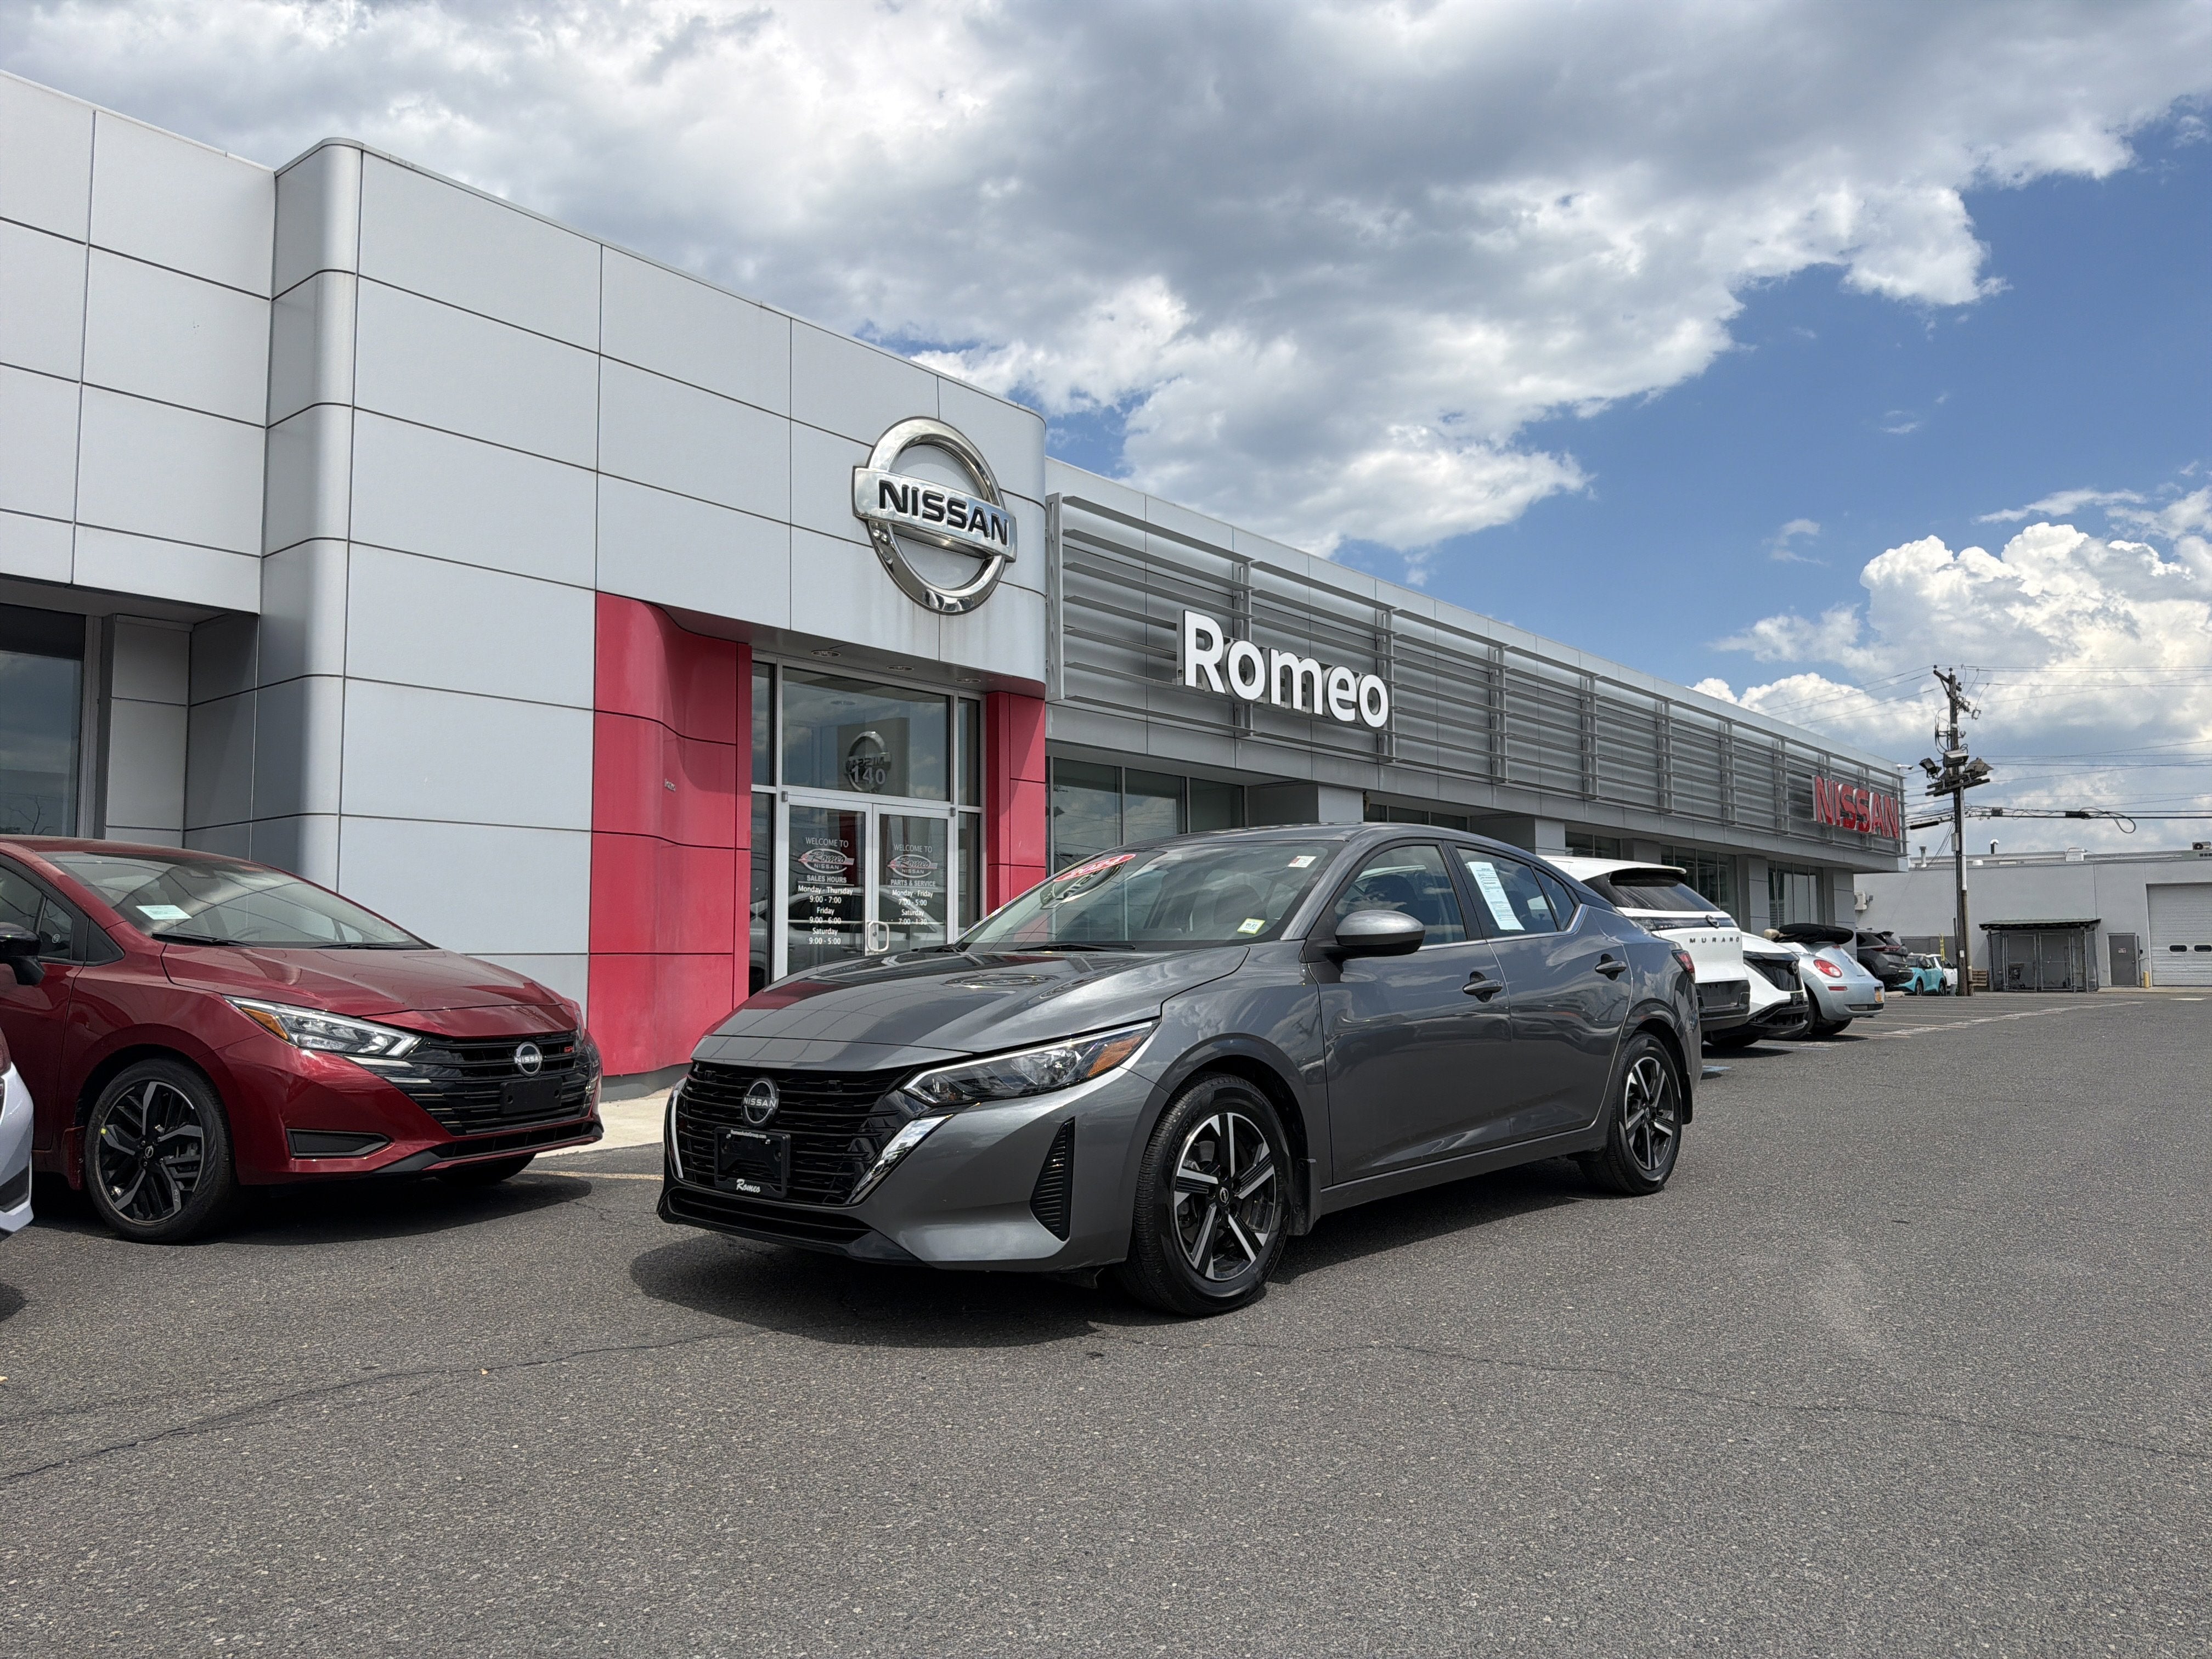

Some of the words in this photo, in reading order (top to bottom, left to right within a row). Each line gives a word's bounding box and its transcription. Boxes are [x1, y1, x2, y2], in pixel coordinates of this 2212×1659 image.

[878, 479, 1009, 547] NISSAN
[1182, 609, 1389, 728] Romeo
[851, 765, 886, 785] 140
[1813, 775, 1899, 840] NISSAN
[805, 837, 838, 847] WELCOME
[839, 839, 849, 848] TO
[894, 844, 923, 853] WELCOME
[809, 850, 845, 864] Romeo
[900, 856, 930, 868] Romeo
[798, 885, 822, 894] Monday
[826, 886, 854, 896] Thursday
[892, 889, 913, 898] Monday
[917, 890, 933, 899] Friday
[809, 895, 823, 903] 9:00
[816, 906, 835, 916] Friday
[901, 909, 925, 917] Saturday
[812, 927, 838, 936] Saturday
[743, 1097, 776, 1107] NISSAN
[736, 1178, 761, 1193] Romeo
